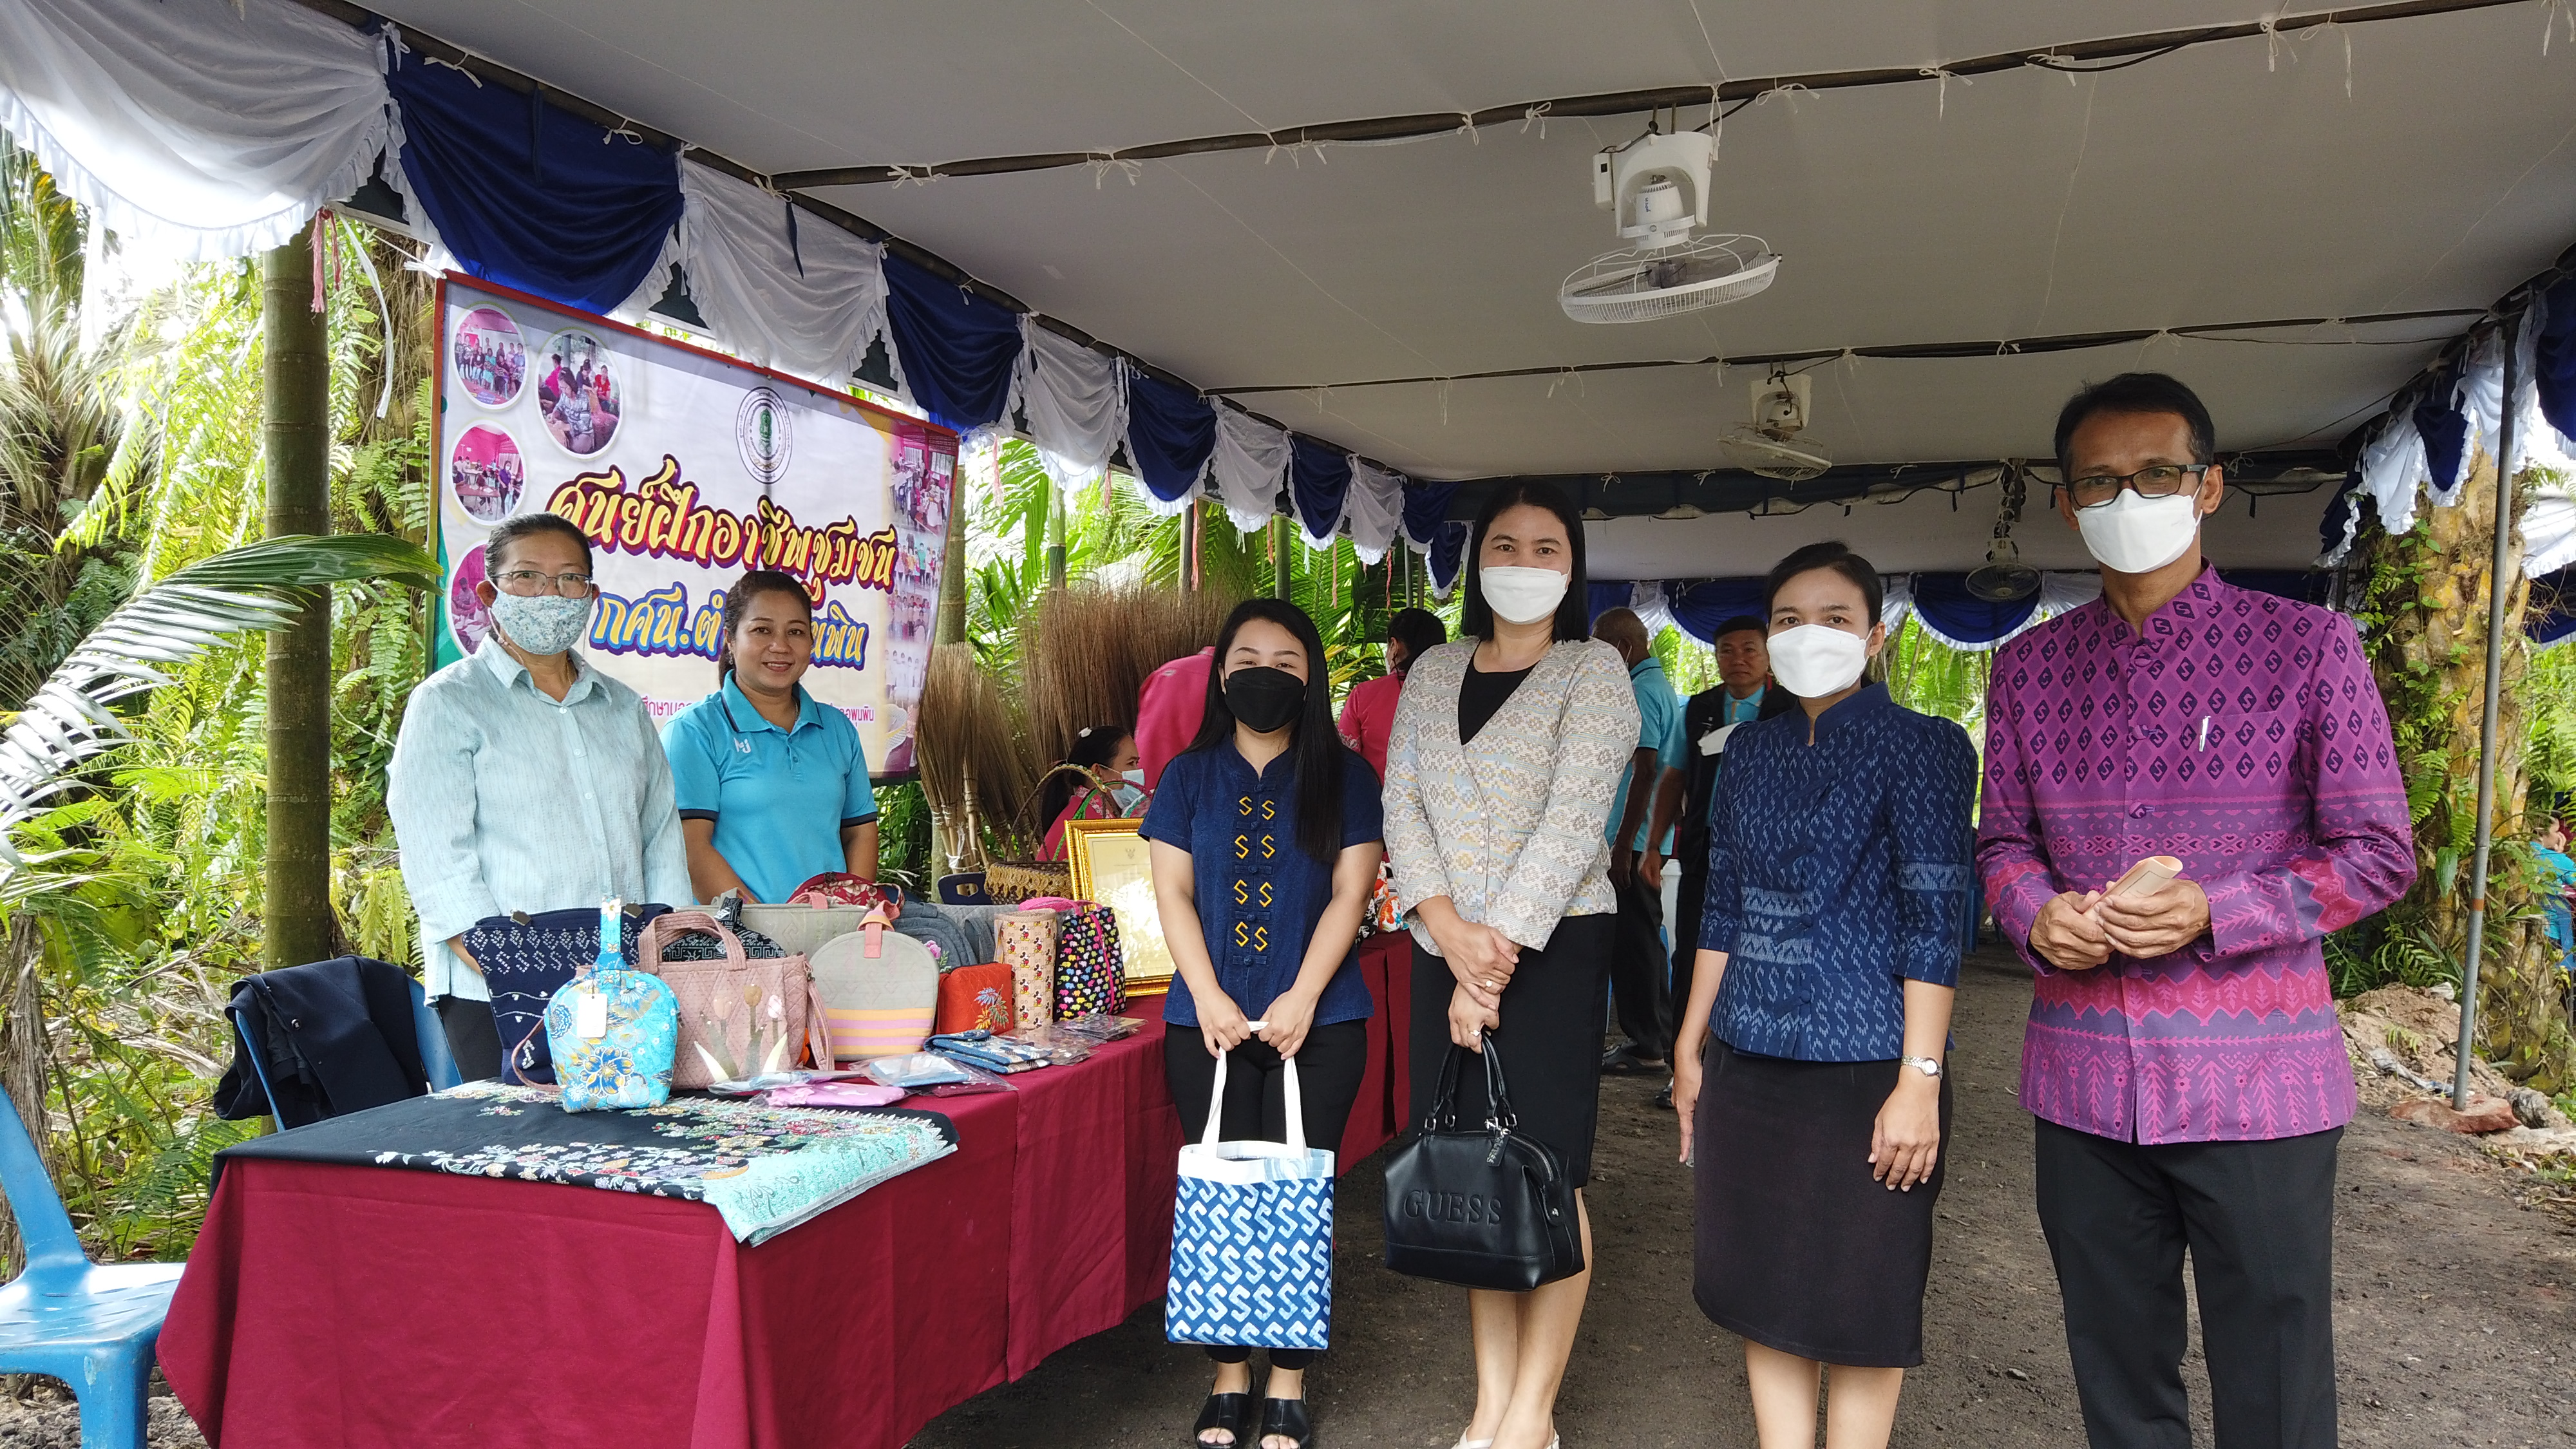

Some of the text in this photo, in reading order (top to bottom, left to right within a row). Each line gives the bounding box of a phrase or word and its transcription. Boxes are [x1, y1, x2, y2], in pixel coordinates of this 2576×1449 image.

[547, 457, 898, 603] ศนย์ฝึกอาชีพชุมชน
[1403, 1189, 1502, 1225] GUESS
